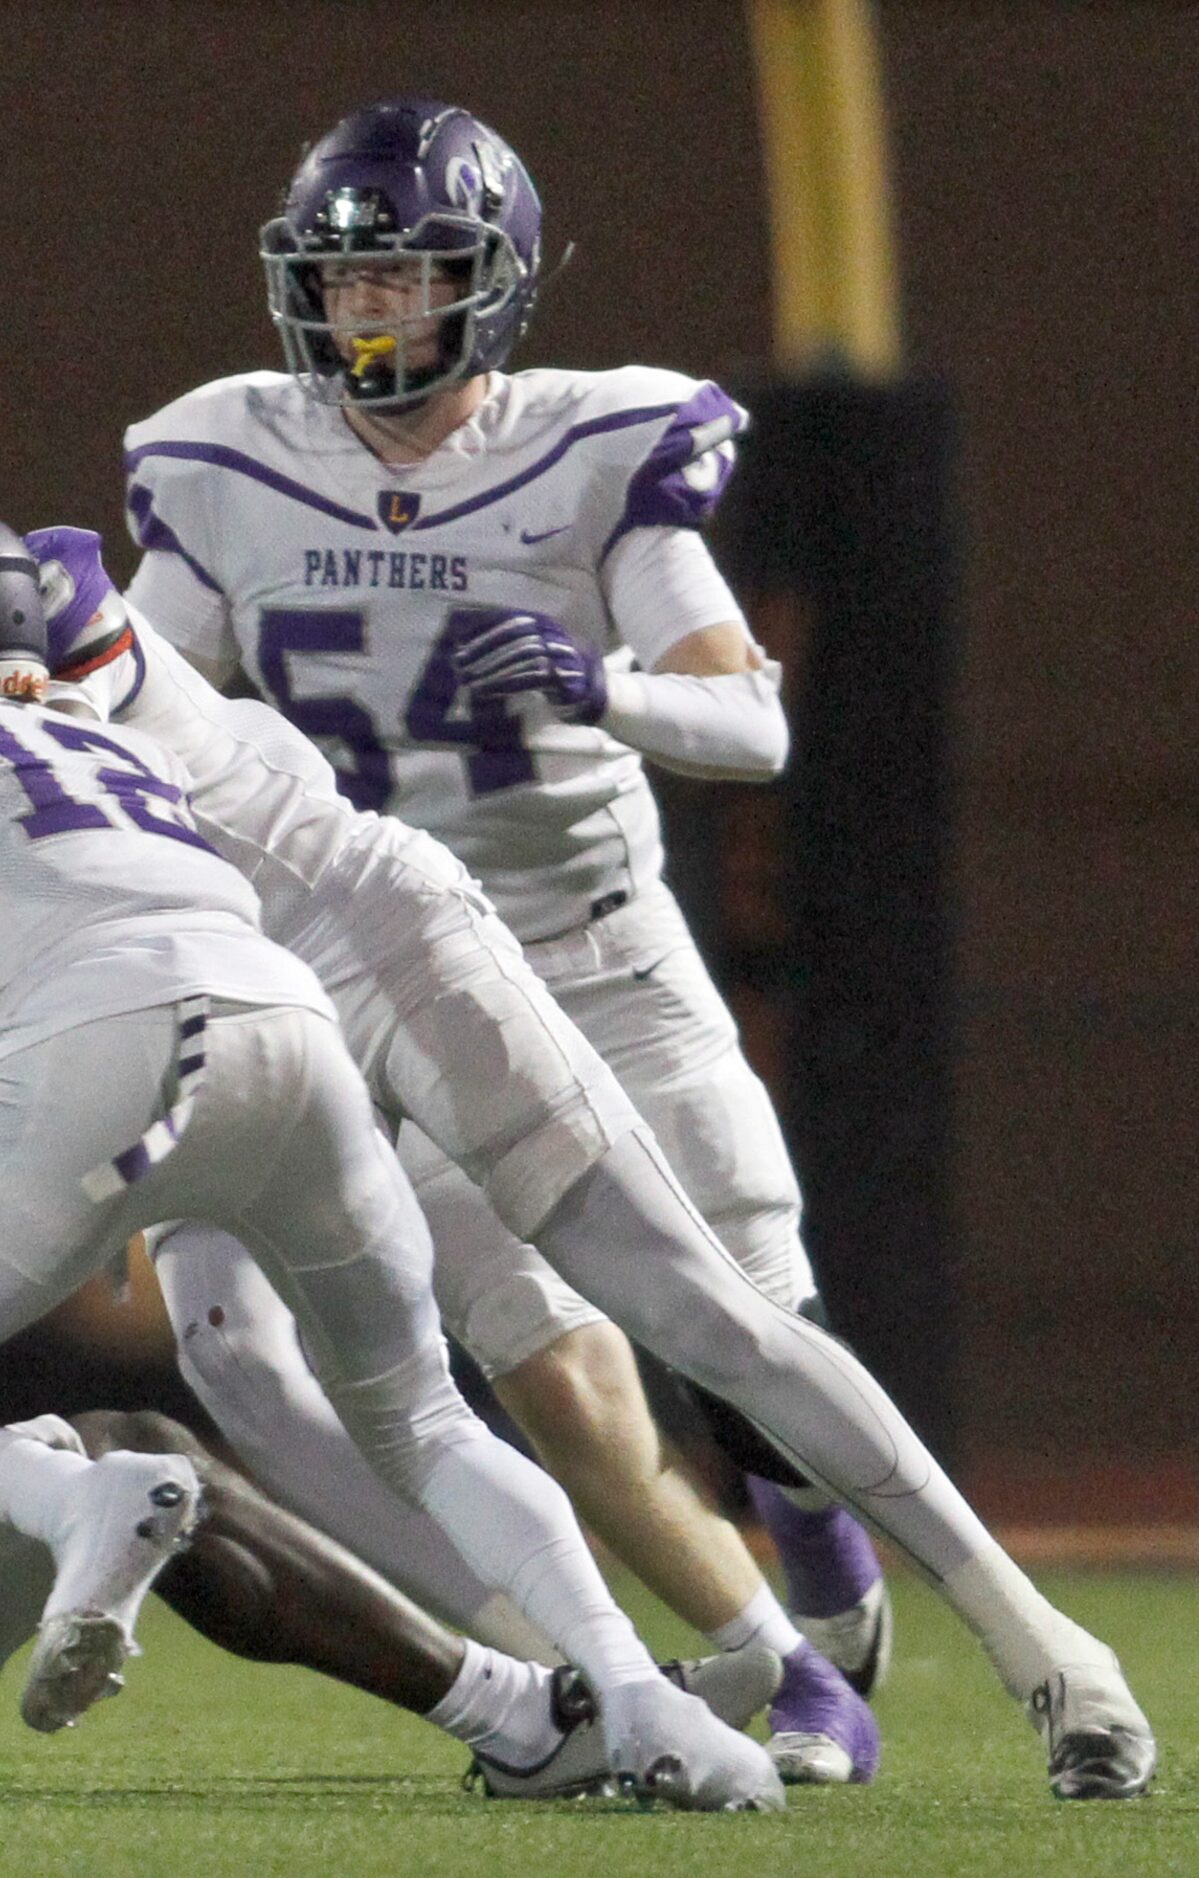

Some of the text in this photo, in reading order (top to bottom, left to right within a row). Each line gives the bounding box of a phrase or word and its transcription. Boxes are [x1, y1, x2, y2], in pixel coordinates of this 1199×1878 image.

[389, 495, 409, 522] L
[303, 549, 469, 590] PANTHERS
[258, 605, 538, 814] 54
